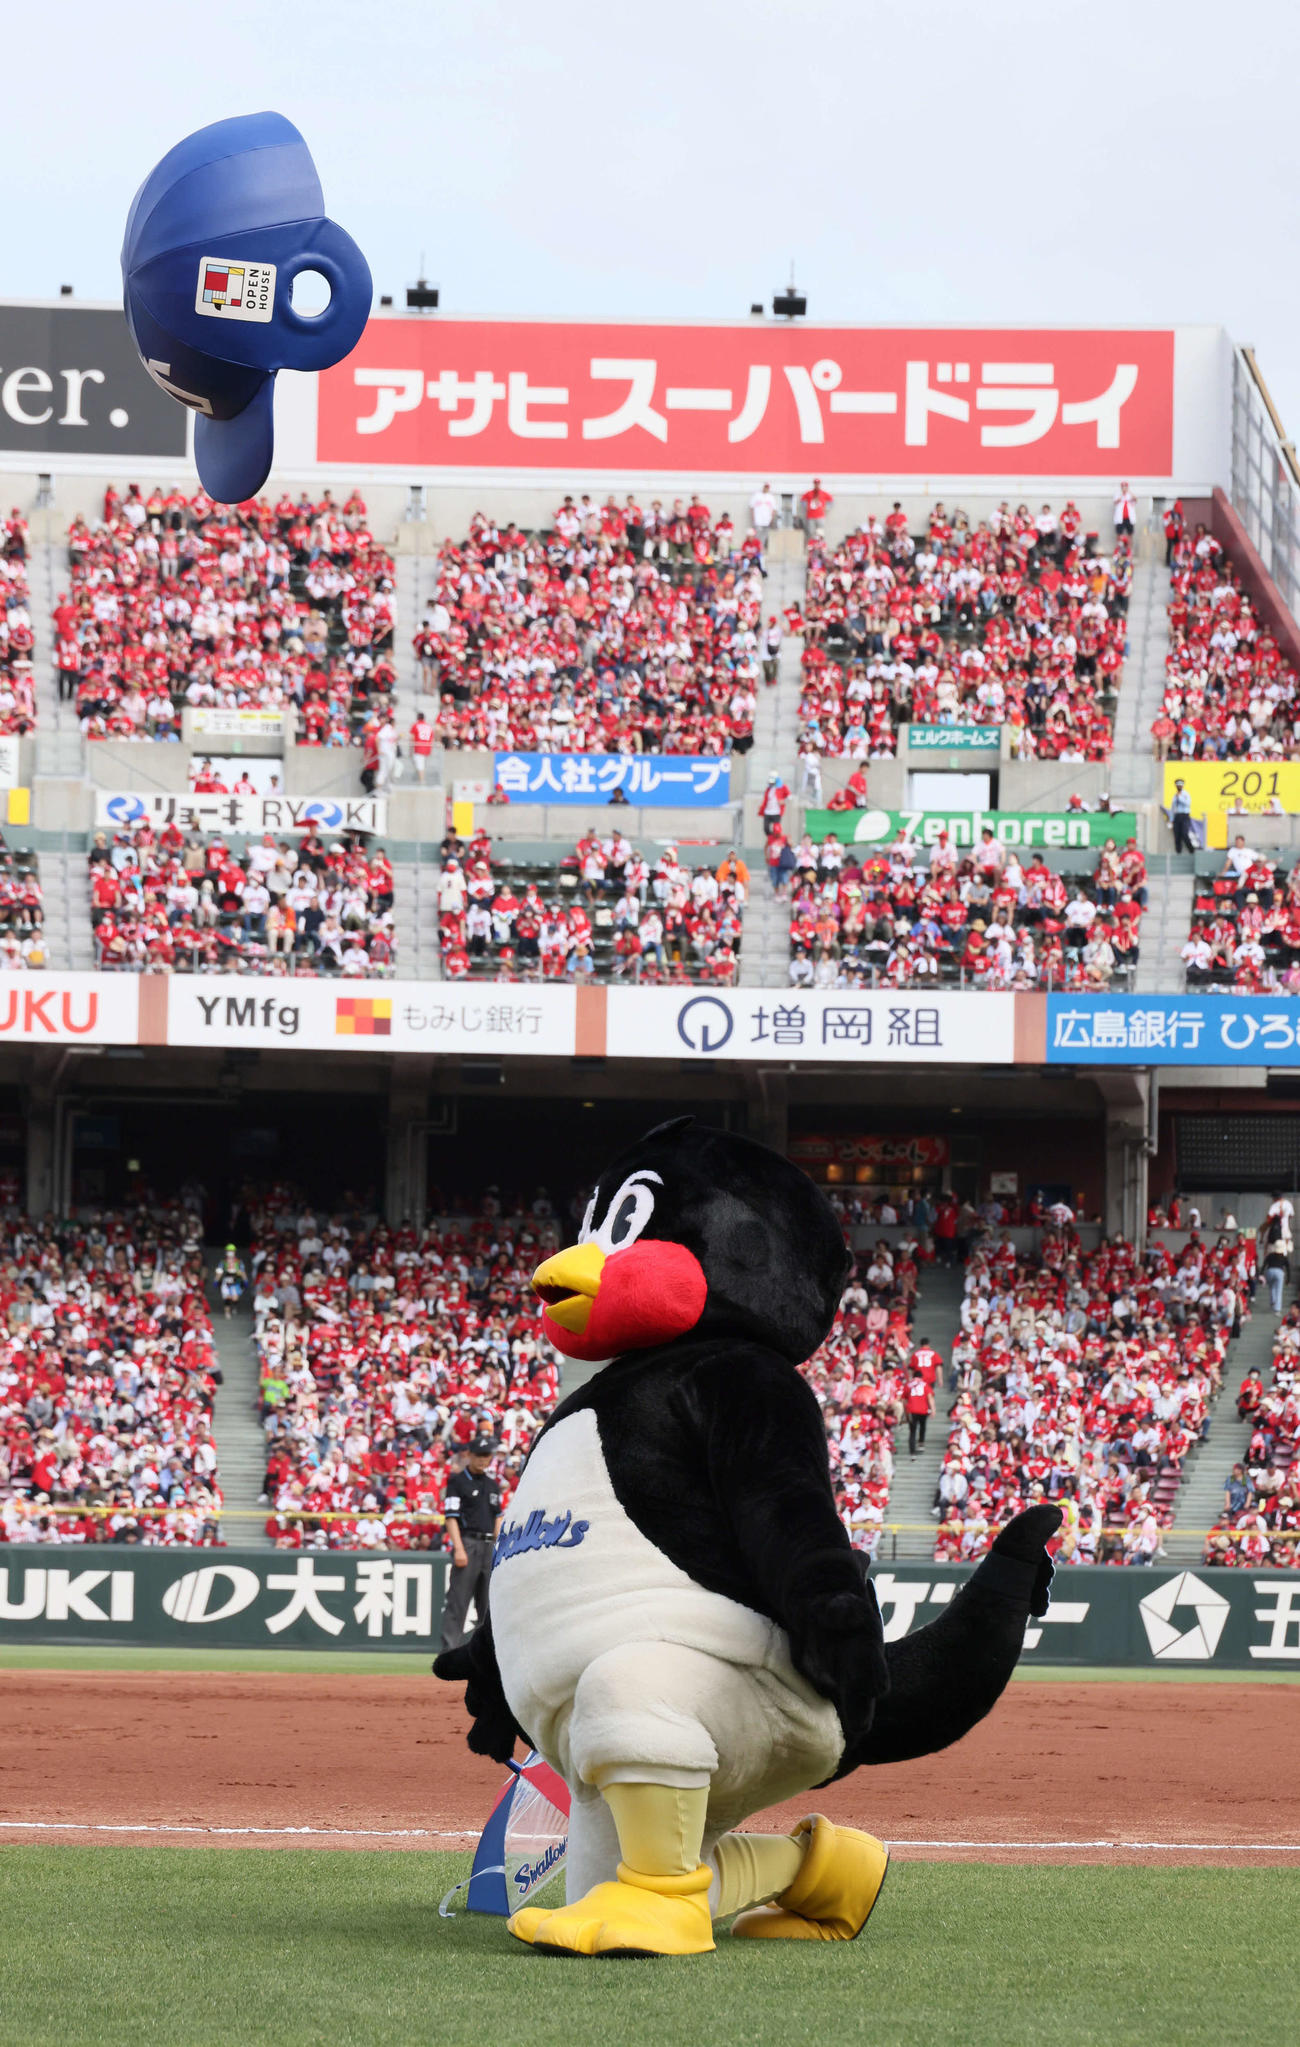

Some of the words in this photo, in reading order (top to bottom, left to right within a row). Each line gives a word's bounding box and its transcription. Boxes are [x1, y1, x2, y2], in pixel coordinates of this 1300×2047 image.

[246, 268, 260, 309] OPEN
[258, 269, 271, 310] HOUSE
[0, 366, 129, 428] er.
[353, 357, 1139, 449] アサヒスーパードライ
[496, 755, 732, 794] 合人社グループ
[154, 797, 243, 826] リョーキ
[196, 995, 301, 1035] YMfg
[402, 1003, 543, 1035] もみじ銀行
[1053, 1008, 1205, 1050] 広島銀行
[1220, 1012, 1300, 1051] ひろ
[513, 1836, 569, 1895] Swallow
